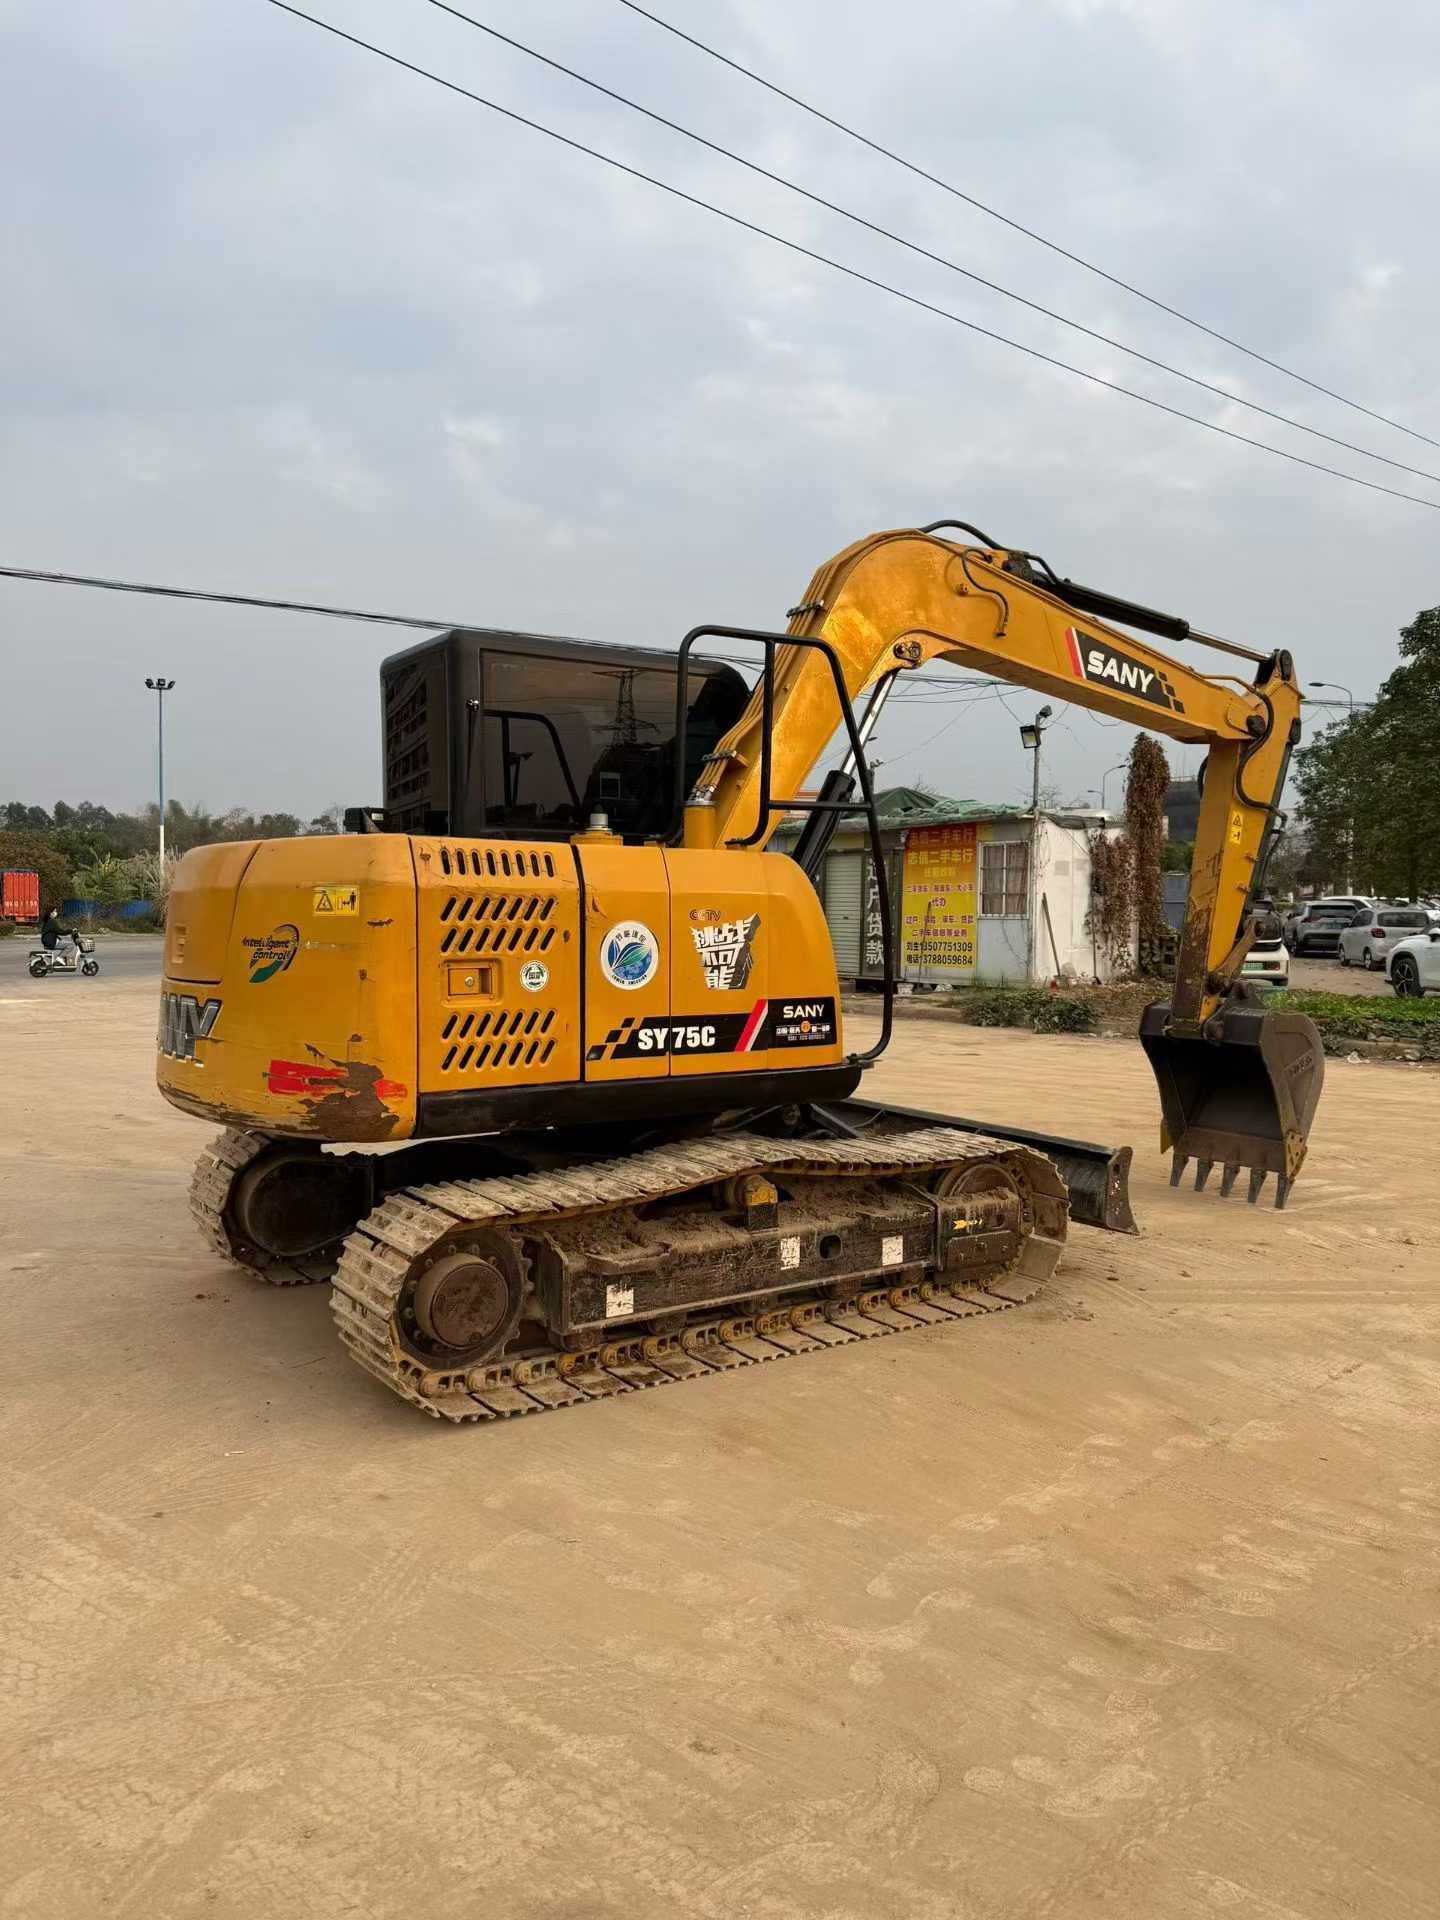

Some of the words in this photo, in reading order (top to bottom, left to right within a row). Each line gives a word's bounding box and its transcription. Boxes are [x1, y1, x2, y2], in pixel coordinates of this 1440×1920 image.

[1087, 650, 1154, 693] SANY
[689, 909, 720, 921] CCTV
[783, 1004, 825, 1018] SANY
